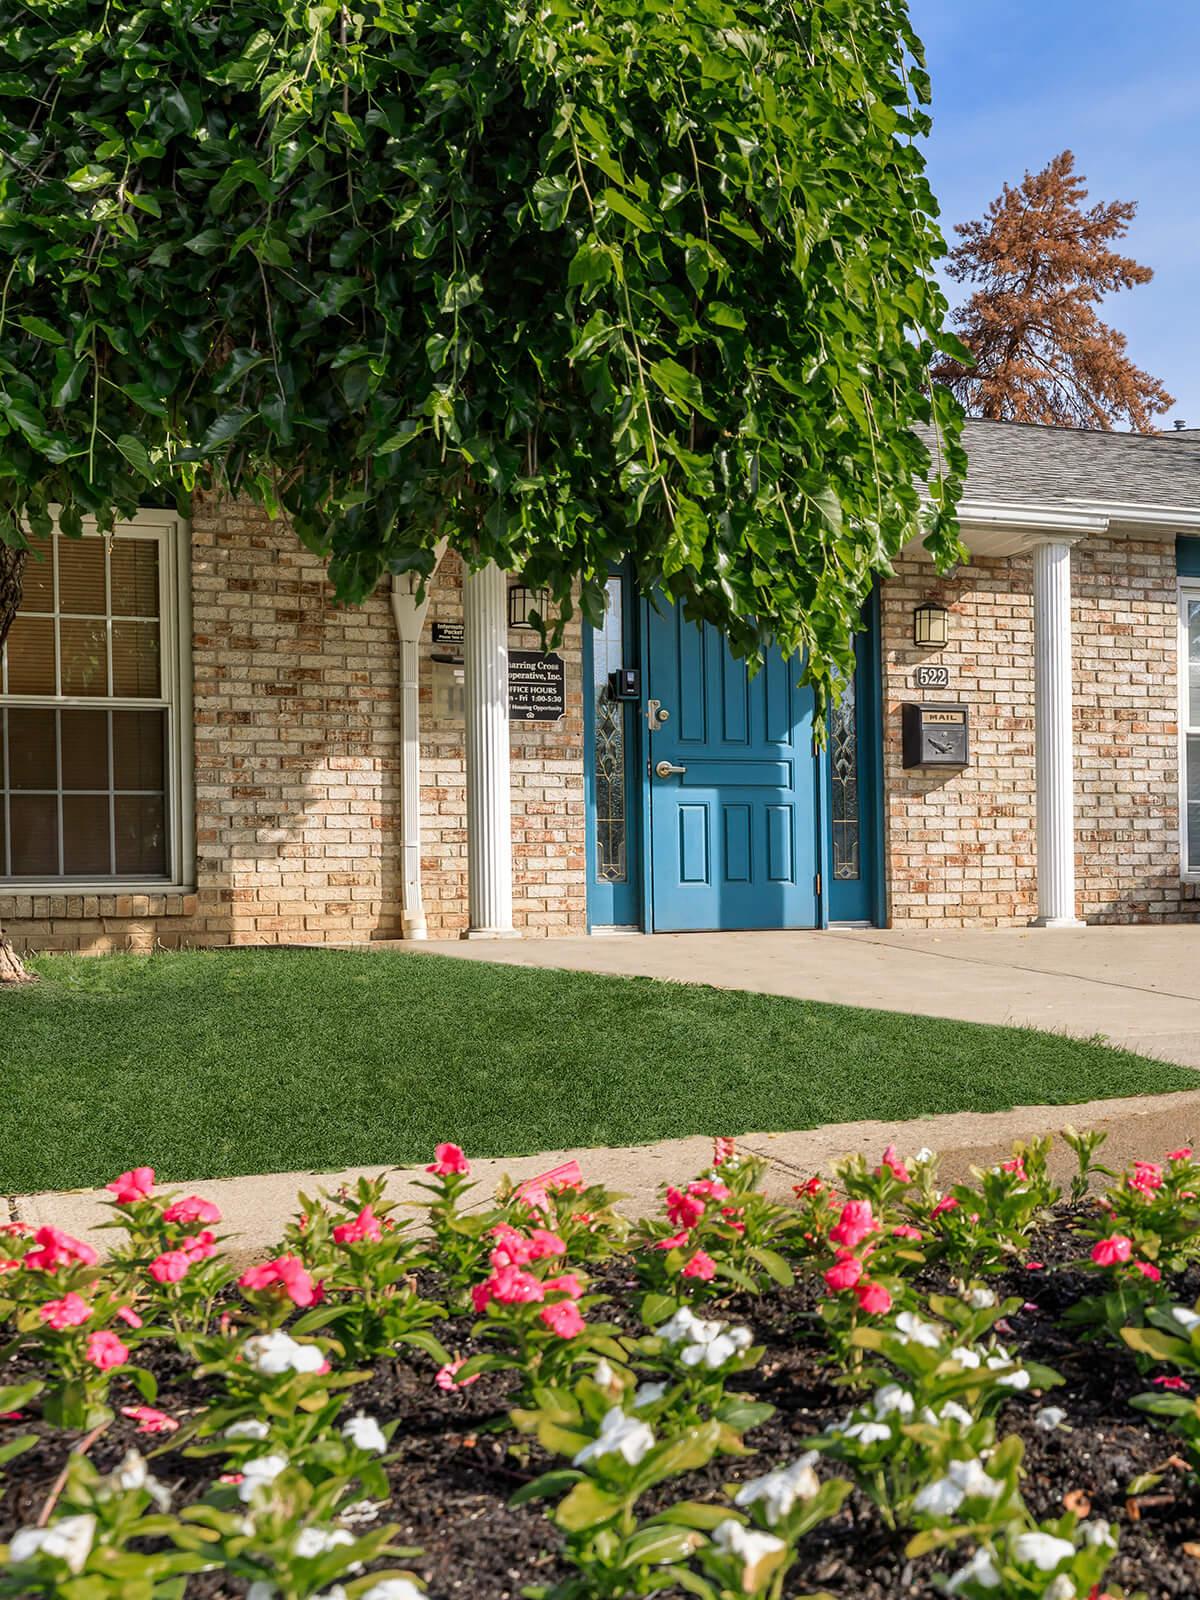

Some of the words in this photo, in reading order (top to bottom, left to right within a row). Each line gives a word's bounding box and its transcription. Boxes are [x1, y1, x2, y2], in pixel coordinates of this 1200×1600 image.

[508, 661, 536, 671] arring
[537, 661, 559, 671] Cross
[508, 671, 546, 681] operative,
[547, 672, 562, 681] Inc.
[920, 668, 946, 684] 522
[509, 686, 529, 694] FFICE
[530, 687, 557, 695] HOURS
[519, 694, 528, 702] Fri
